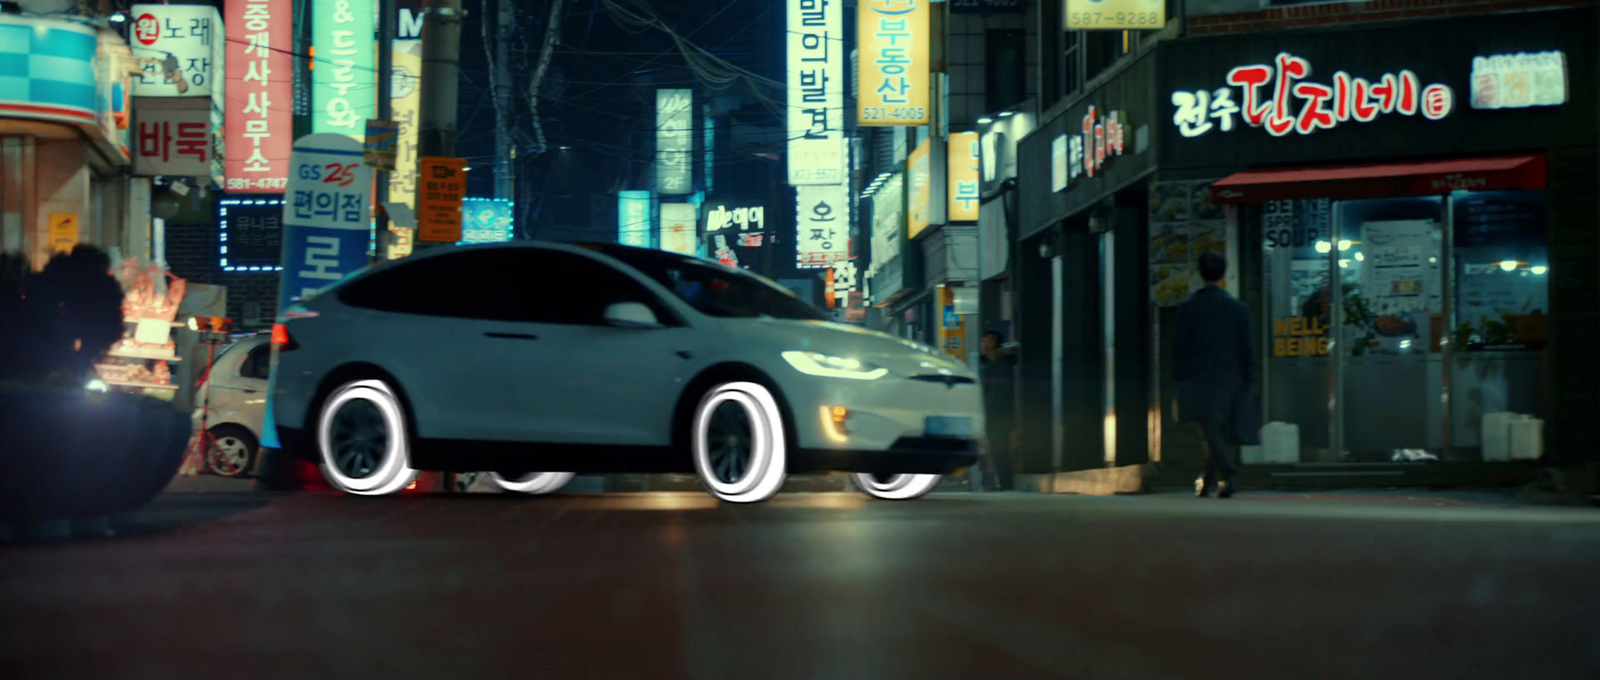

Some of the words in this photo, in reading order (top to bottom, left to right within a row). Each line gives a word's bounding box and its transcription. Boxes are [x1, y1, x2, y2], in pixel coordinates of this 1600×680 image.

[1071, 12, 1159, 26] 587-9288
[243, 0, 272, 87] 중개사
[876, 18, 912, 104] 부동산
[1171, 86, 1240, 138] 전주
[1226, 52, 1420, 136] 단지네
[862, 106, 926, 120] 521-4005
[139, 120, 209, 163] 바둑
[227, 177, 289, 190] 581-4747
[298, 162, 361, 188] GS25
[664, 176, 685, 190] 2F
[293, 189, 363, 223] 편의점
[1266, 228, 1320, 248] SOUP
[1273, 336, 1328, 357] BEING
